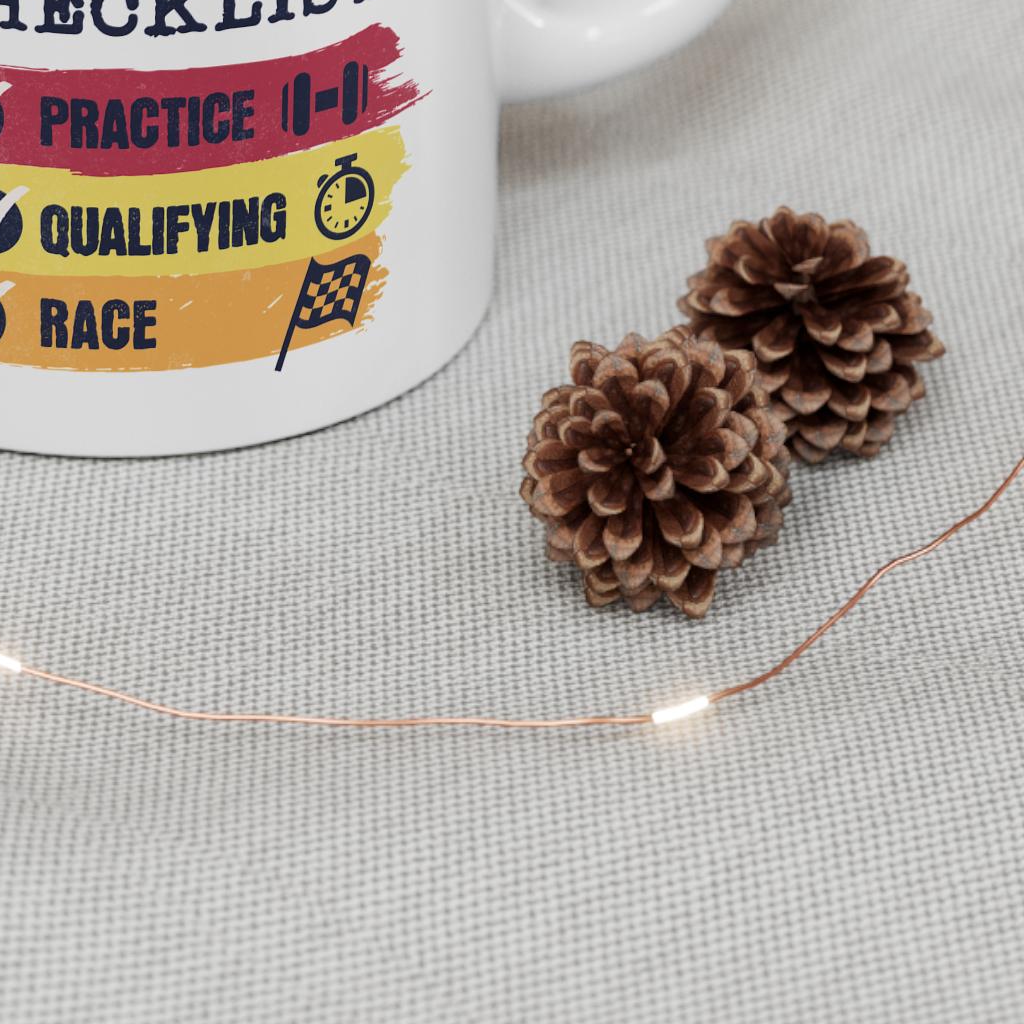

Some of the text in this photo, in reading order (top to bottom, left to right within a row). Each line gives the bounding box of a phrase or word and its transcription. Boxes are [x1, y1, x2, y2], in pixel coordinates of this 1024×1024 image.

[40, 89, 255, 150] PRACTICE
[40, 192, 287, 257] QUALIFYING
[40, 298, 157, 351] RACE
